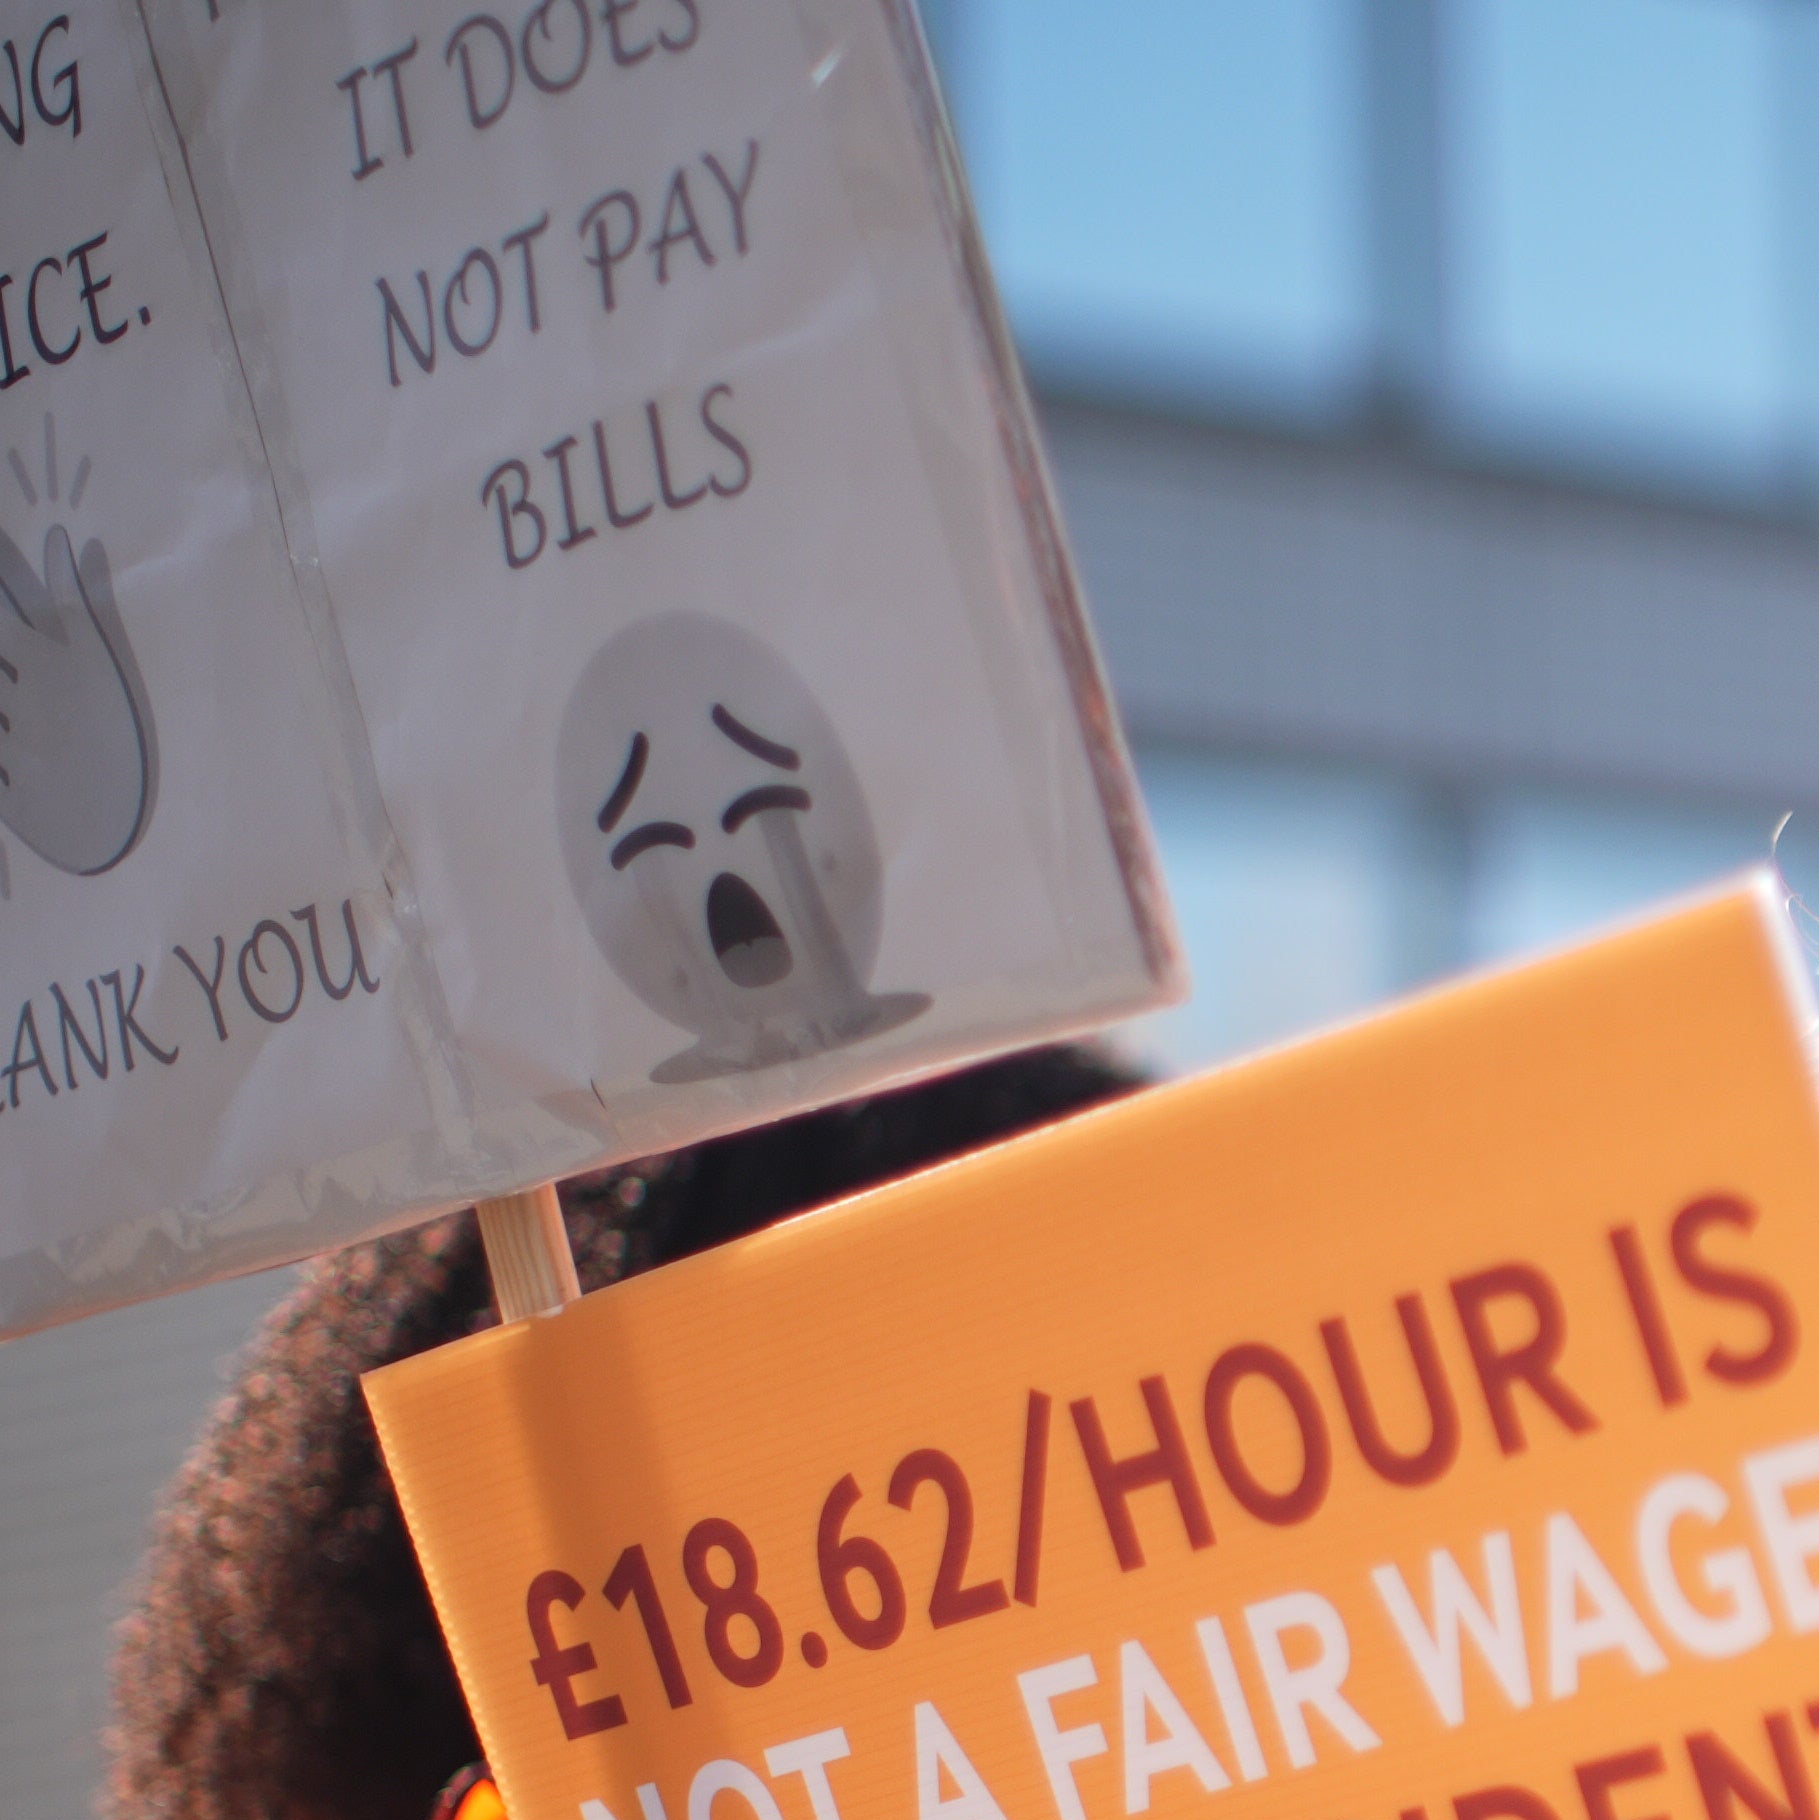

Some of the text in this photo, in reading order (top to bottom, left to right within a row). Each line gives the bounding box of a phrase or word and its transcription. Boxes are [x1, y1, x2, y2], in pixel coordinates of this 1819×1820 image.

[336, 40, 418, 181] IT
[377, 139, 761, 387] NOT PAY
[481, 384, 752, 570] BILLS
[0, 899, 380, 1112] ANK YOU
[524, 1193, 1801, 1741] £18.62/HOUR IS
